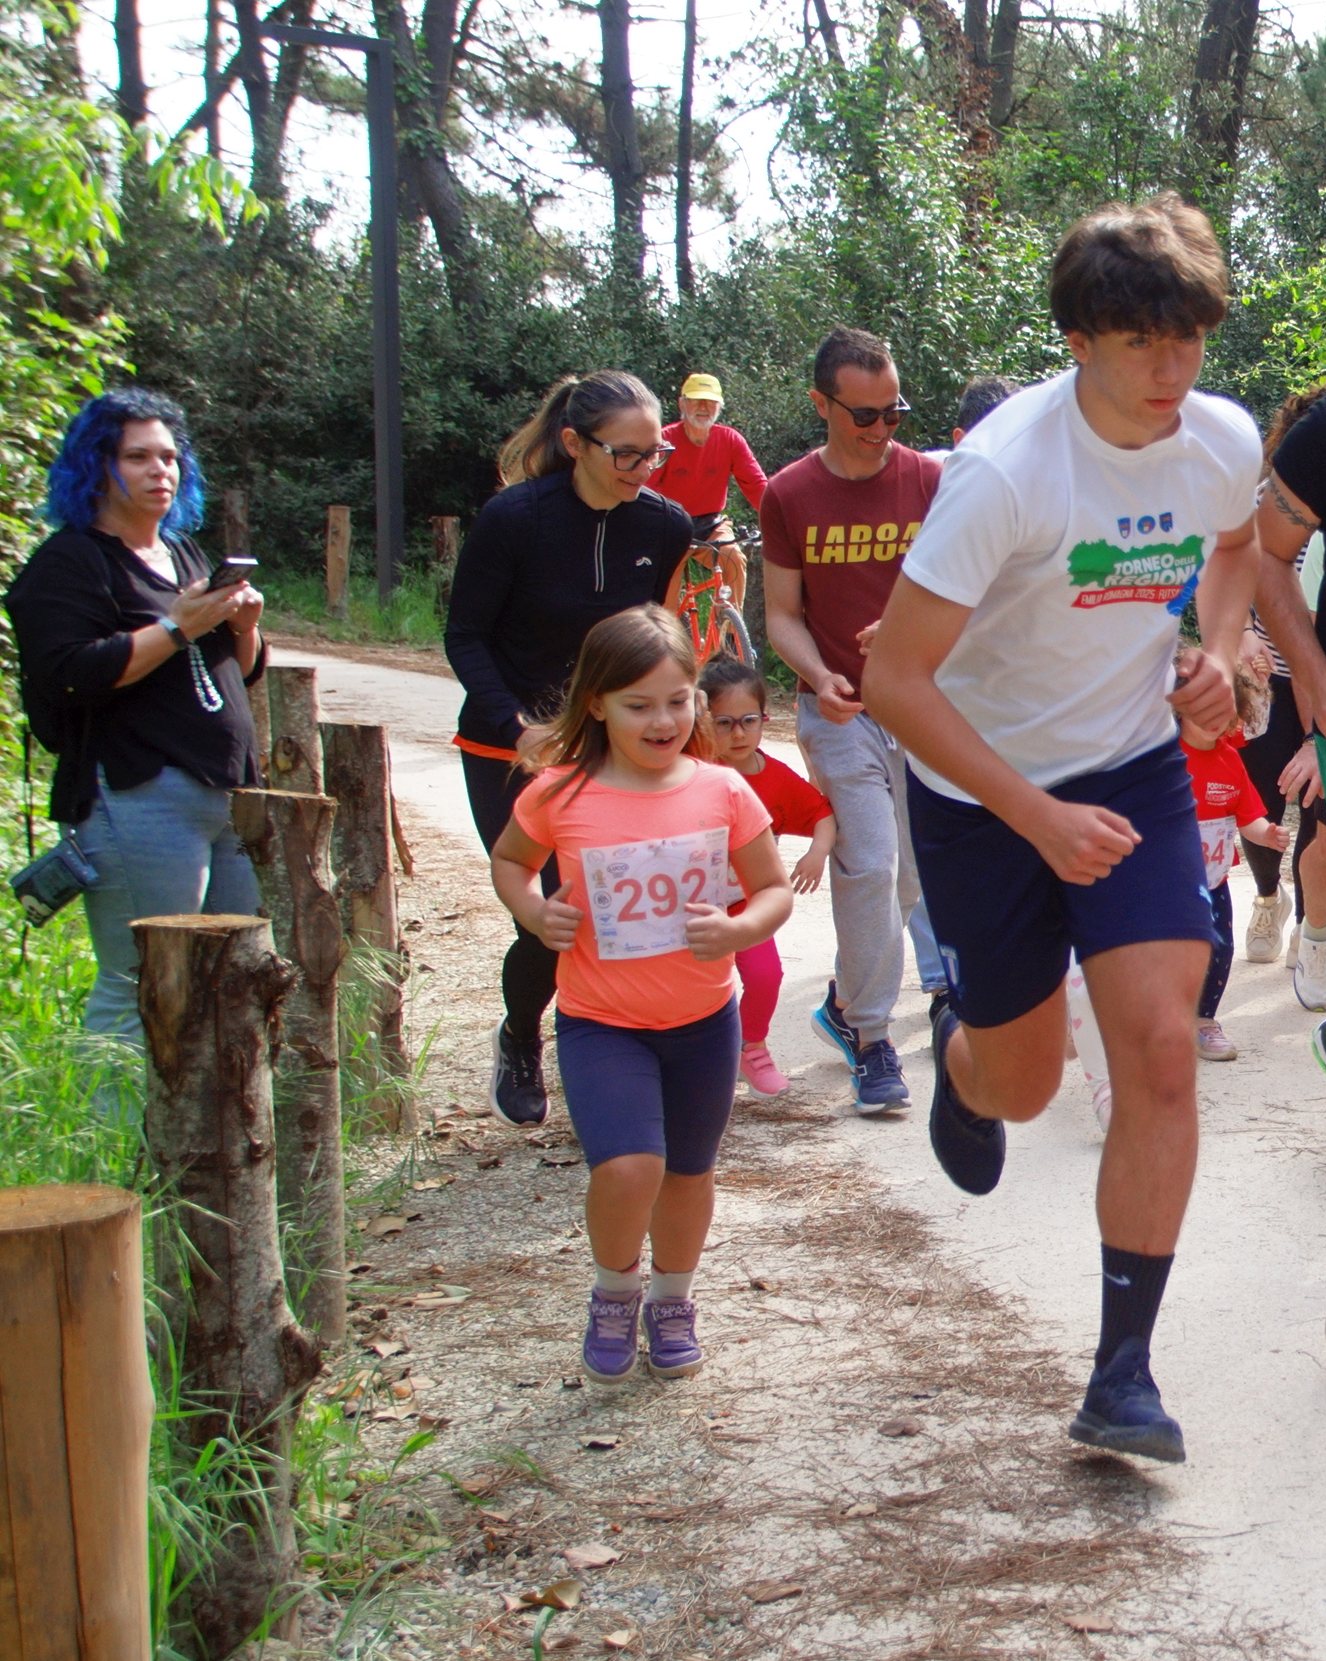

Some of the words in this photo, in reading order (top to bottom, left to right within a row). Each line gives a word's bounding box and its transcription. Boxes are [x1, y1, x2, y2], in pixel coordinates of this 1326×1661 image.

[1113, 553, 1174, 577] TORNEO
[1174, 555, 1197, 568] DELLE
[1134, 588, 1156, 600] 2025
[613, 867, 708, 923] 292
